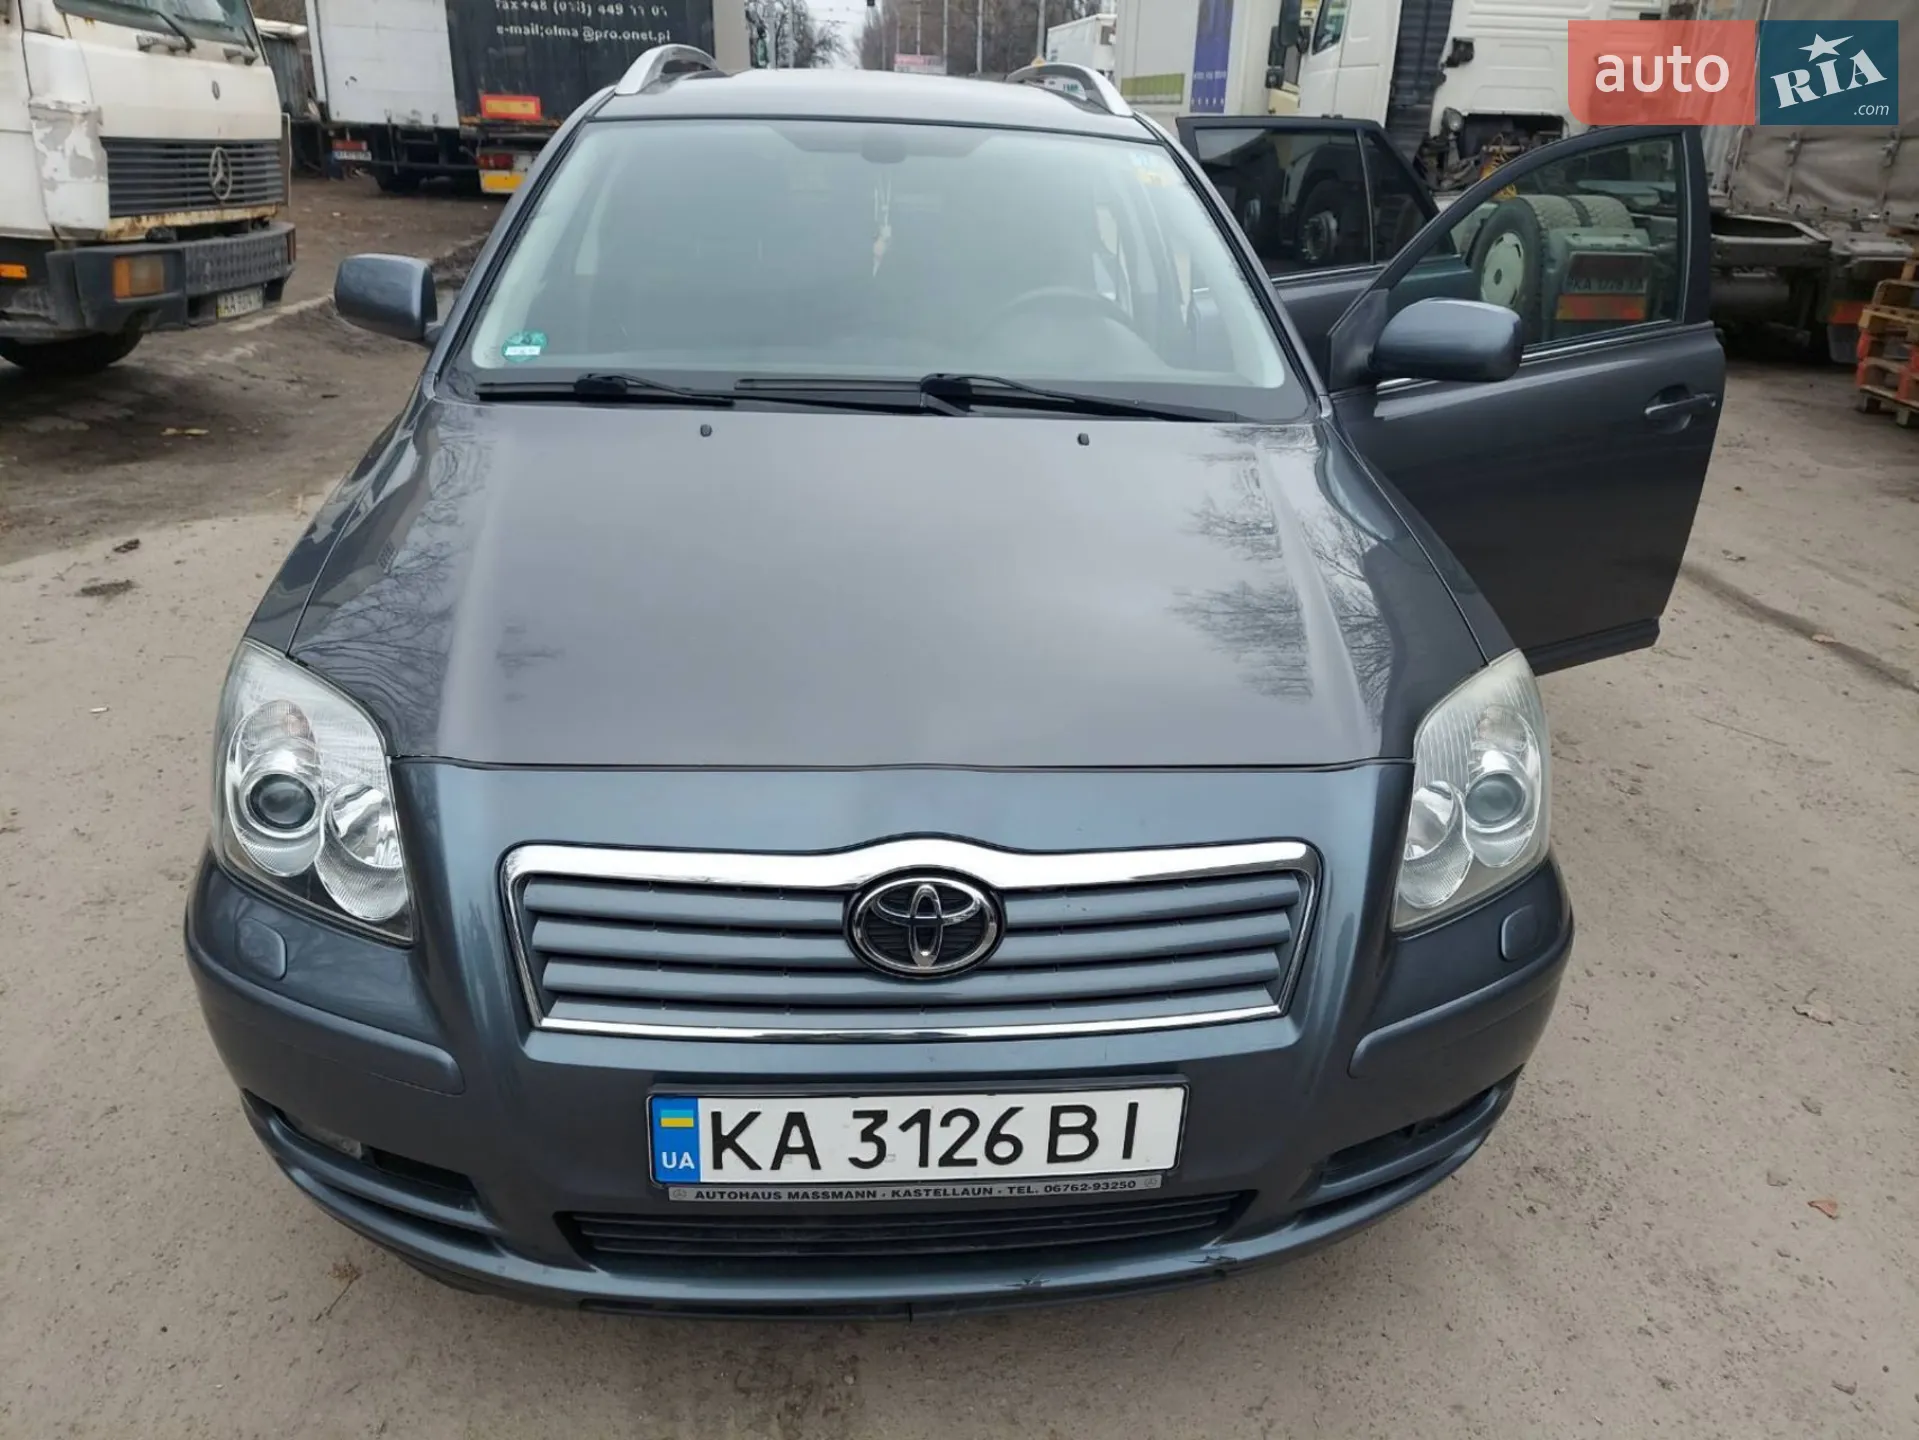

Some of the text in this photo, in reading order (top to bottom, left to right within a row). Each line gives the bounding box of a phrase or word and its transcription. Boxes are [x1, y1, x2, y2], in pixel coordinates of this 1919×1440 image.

[711, 1102, 1139, 1170] KA 3126 BI
[662, 1151, 695, 1169] UA
[694, 1180, 1137, 1201] AUTOHAUS MASSMANN KASTELLAUN TEL. 06762-93250
